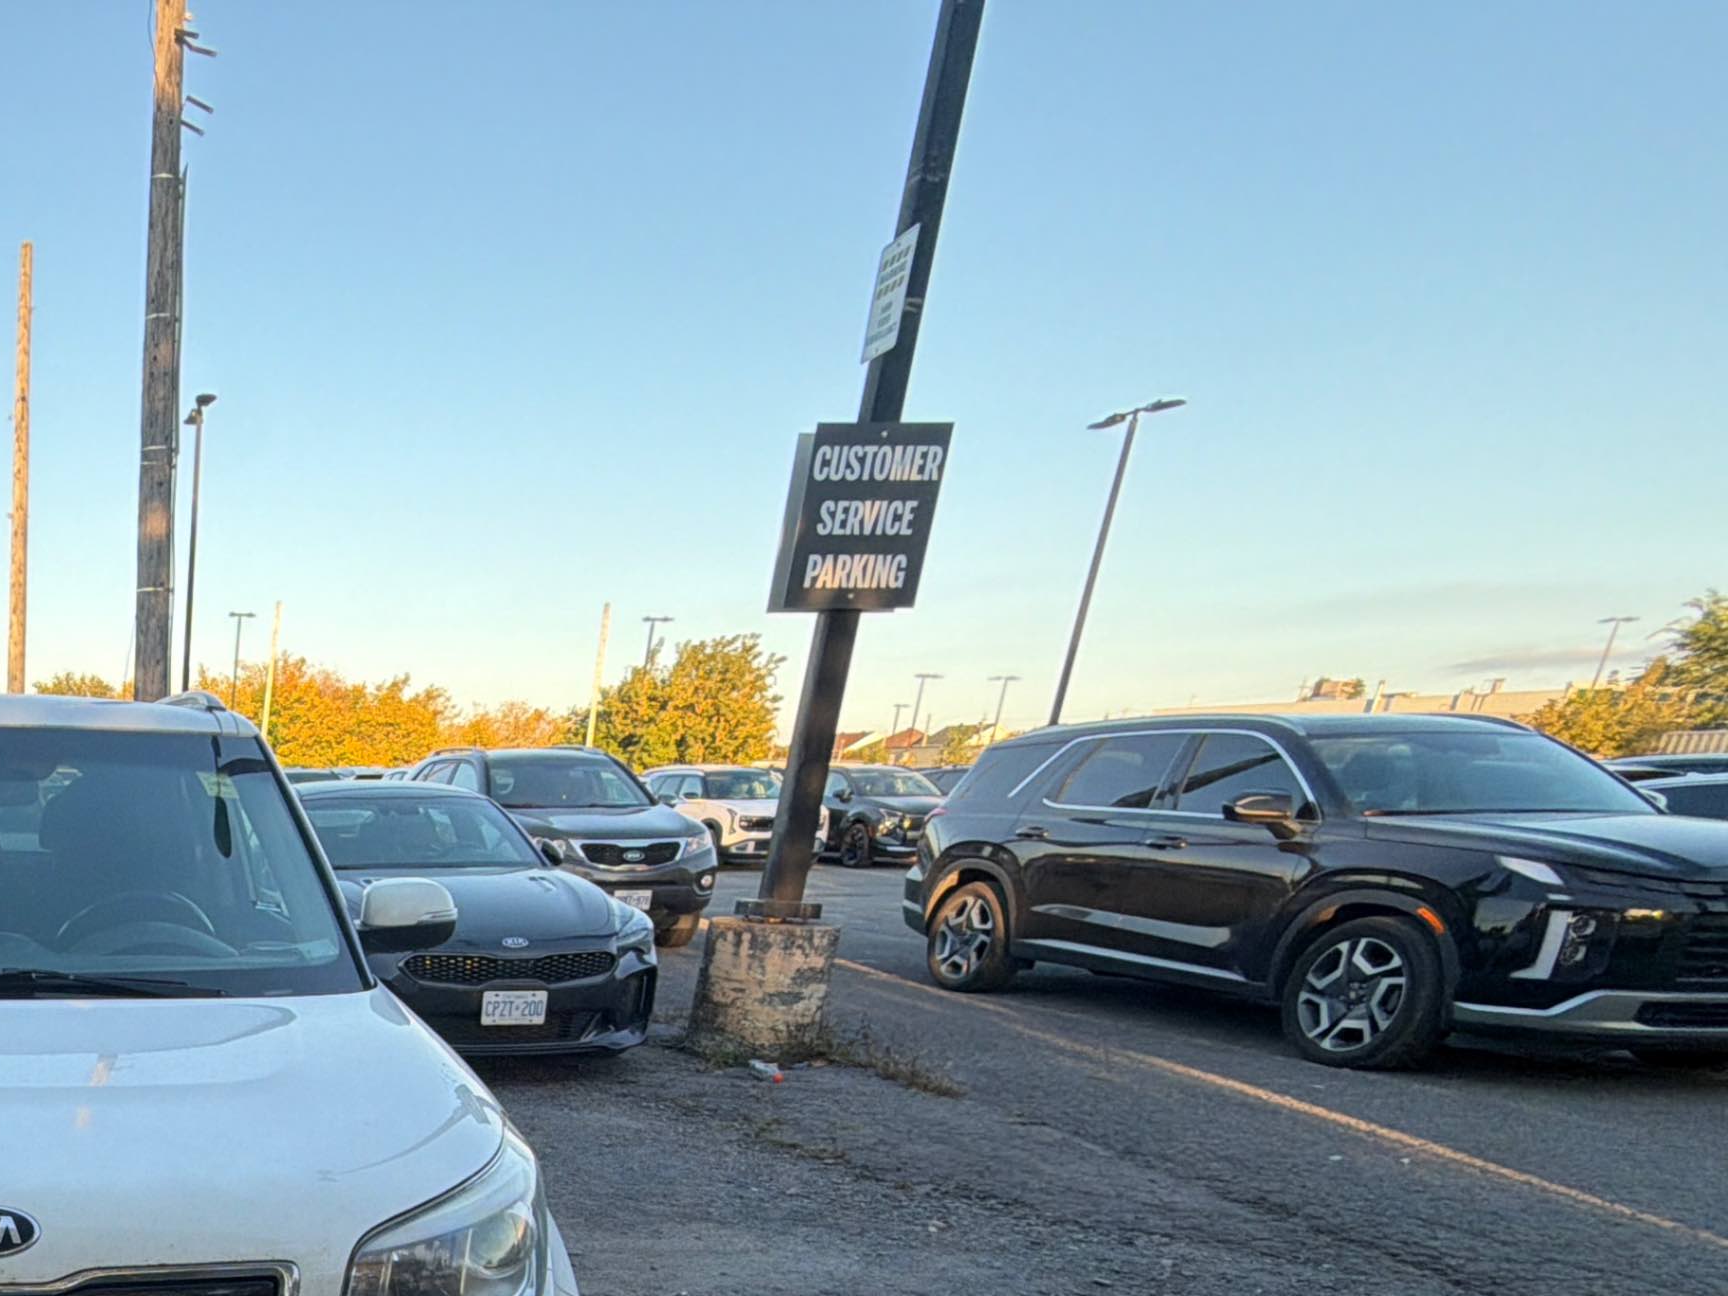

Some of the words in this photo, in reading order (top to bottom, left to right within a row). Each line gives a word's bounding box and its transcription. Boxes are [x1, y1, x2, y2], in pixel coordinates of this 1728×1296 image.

[812, 445, 943, 481] CUSTOMER
[816, 500, 919, 536] SERVICE
[802, 554, 908, 589] PARKING
